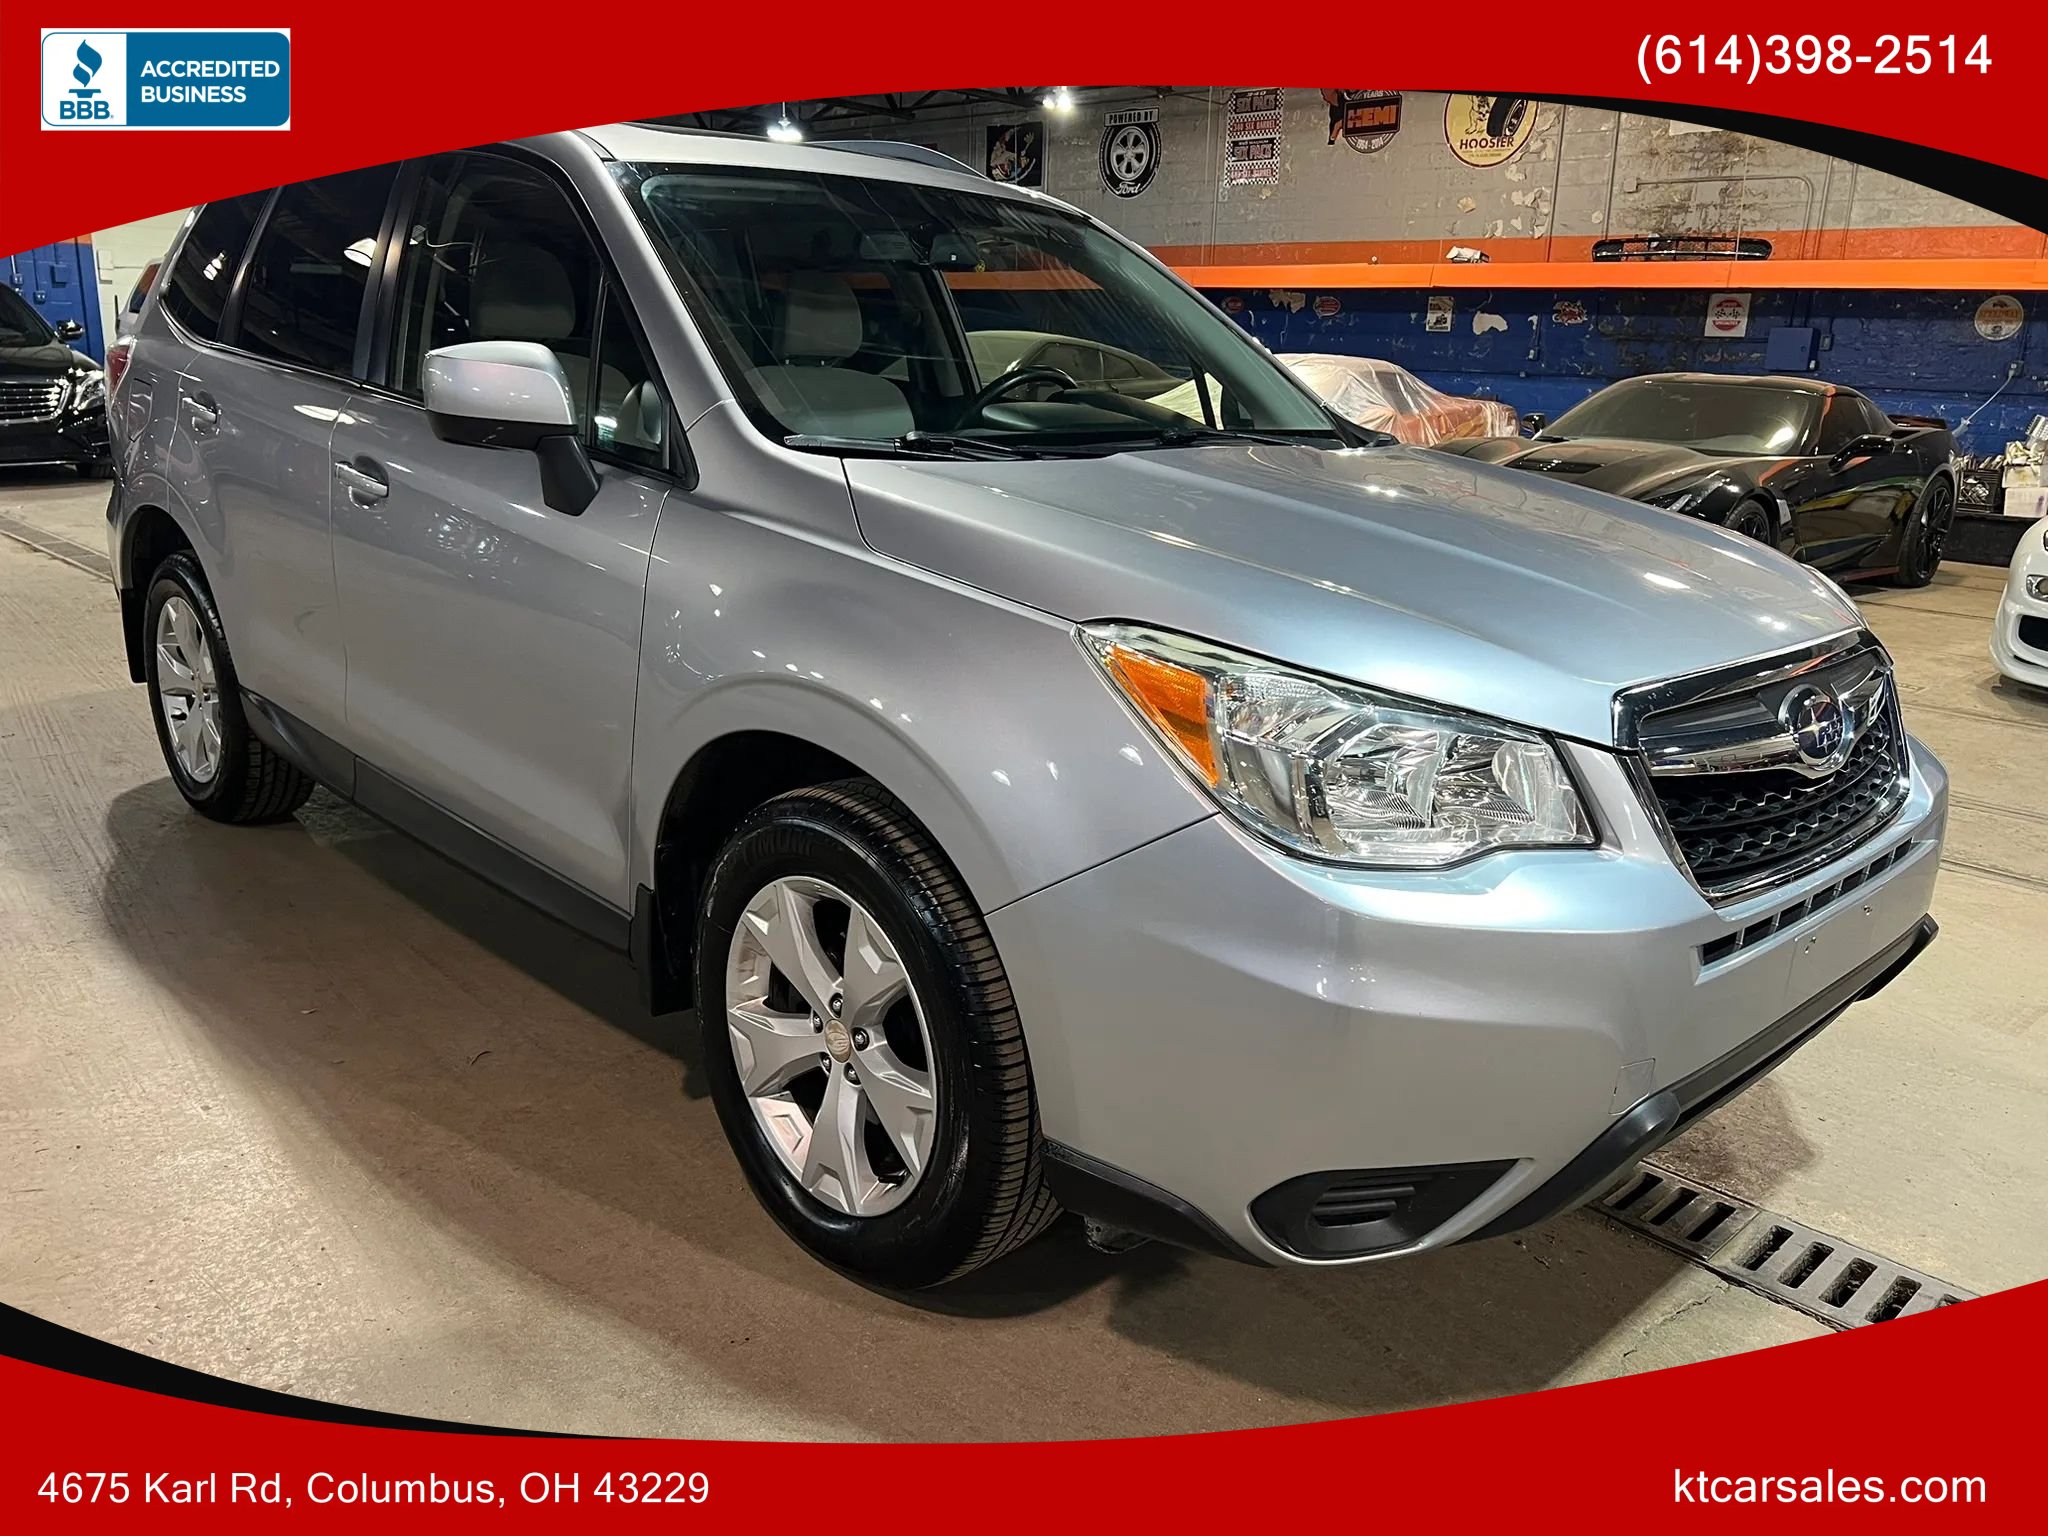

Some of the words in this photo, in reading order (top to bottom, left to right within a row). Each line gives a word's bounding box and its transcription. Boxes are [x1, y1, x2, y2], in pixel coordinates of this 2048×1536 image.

[1109, 111, 1141, 124] POWERED
[1144, 110, 1154, 121] BY
[1347, 105, 1397, 128] HEMI
[1460, 137, 1514, 150] HOOSIER
[1116, 182, 1141, 194] Ford
